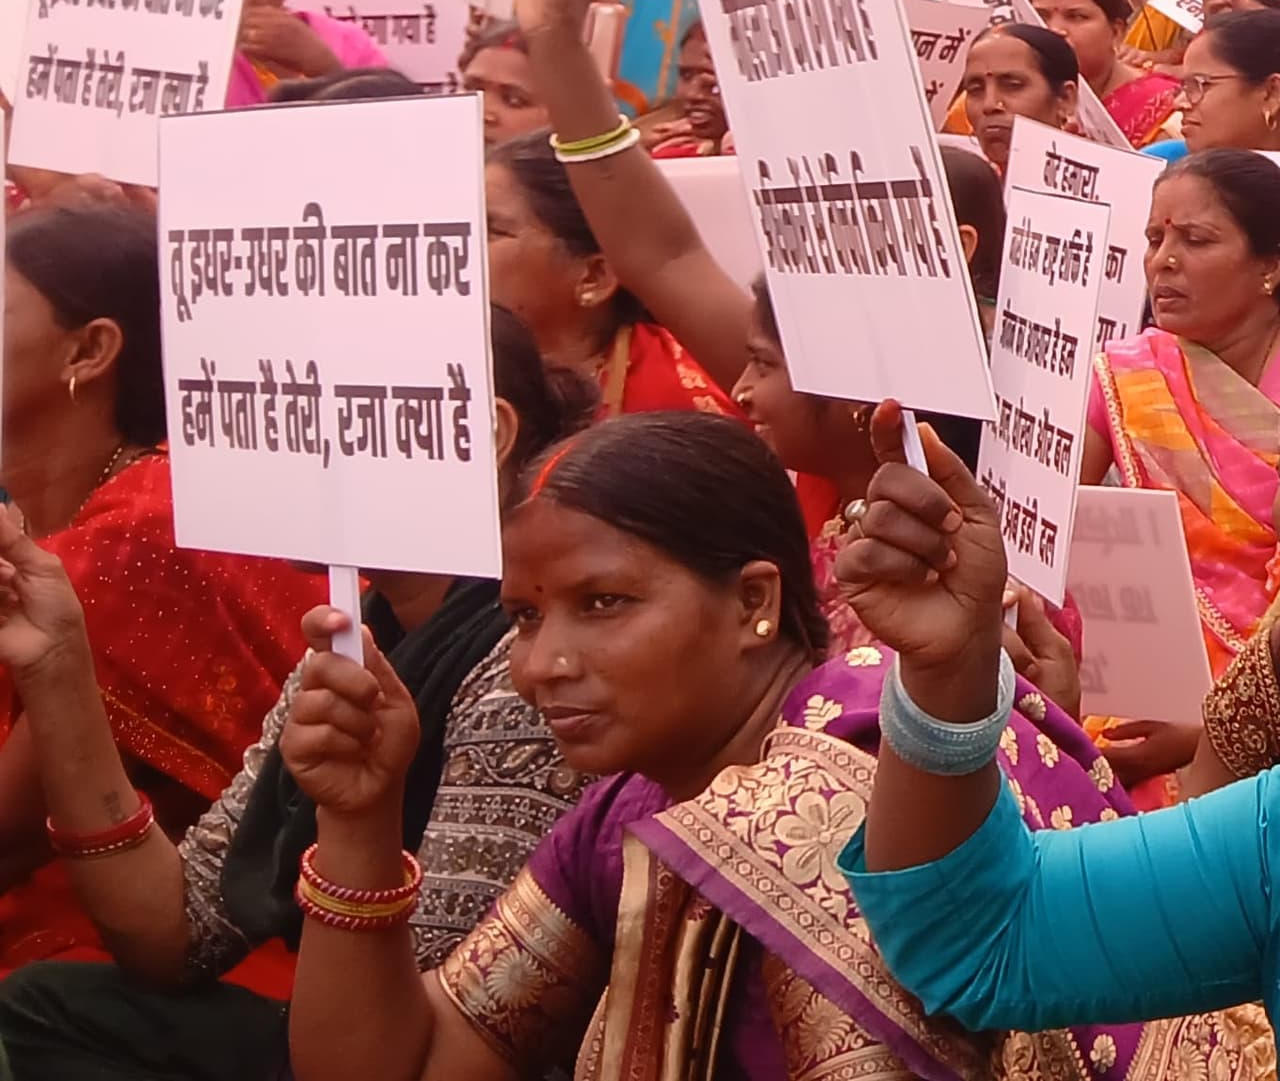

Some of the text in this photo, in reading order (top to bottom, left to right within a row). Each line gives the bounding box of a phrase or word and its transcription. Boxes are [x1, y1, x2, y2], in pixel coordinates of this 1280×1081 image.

[26, 43, 209, 119] हमें पता है तेरी, रजा क्या है
[1044, 141, 1061, 189] वोट
[168, 202, 471, 322] तू इधर-उधर की बात ना कर
[1105, 245, 1127, 284] का
[178, 357, 471, 469] हमें पता है तेरी, रजा क्या है
[1034, 408, 1074, 477] और बल
[1004, 498, 1057, 568] अब दल
